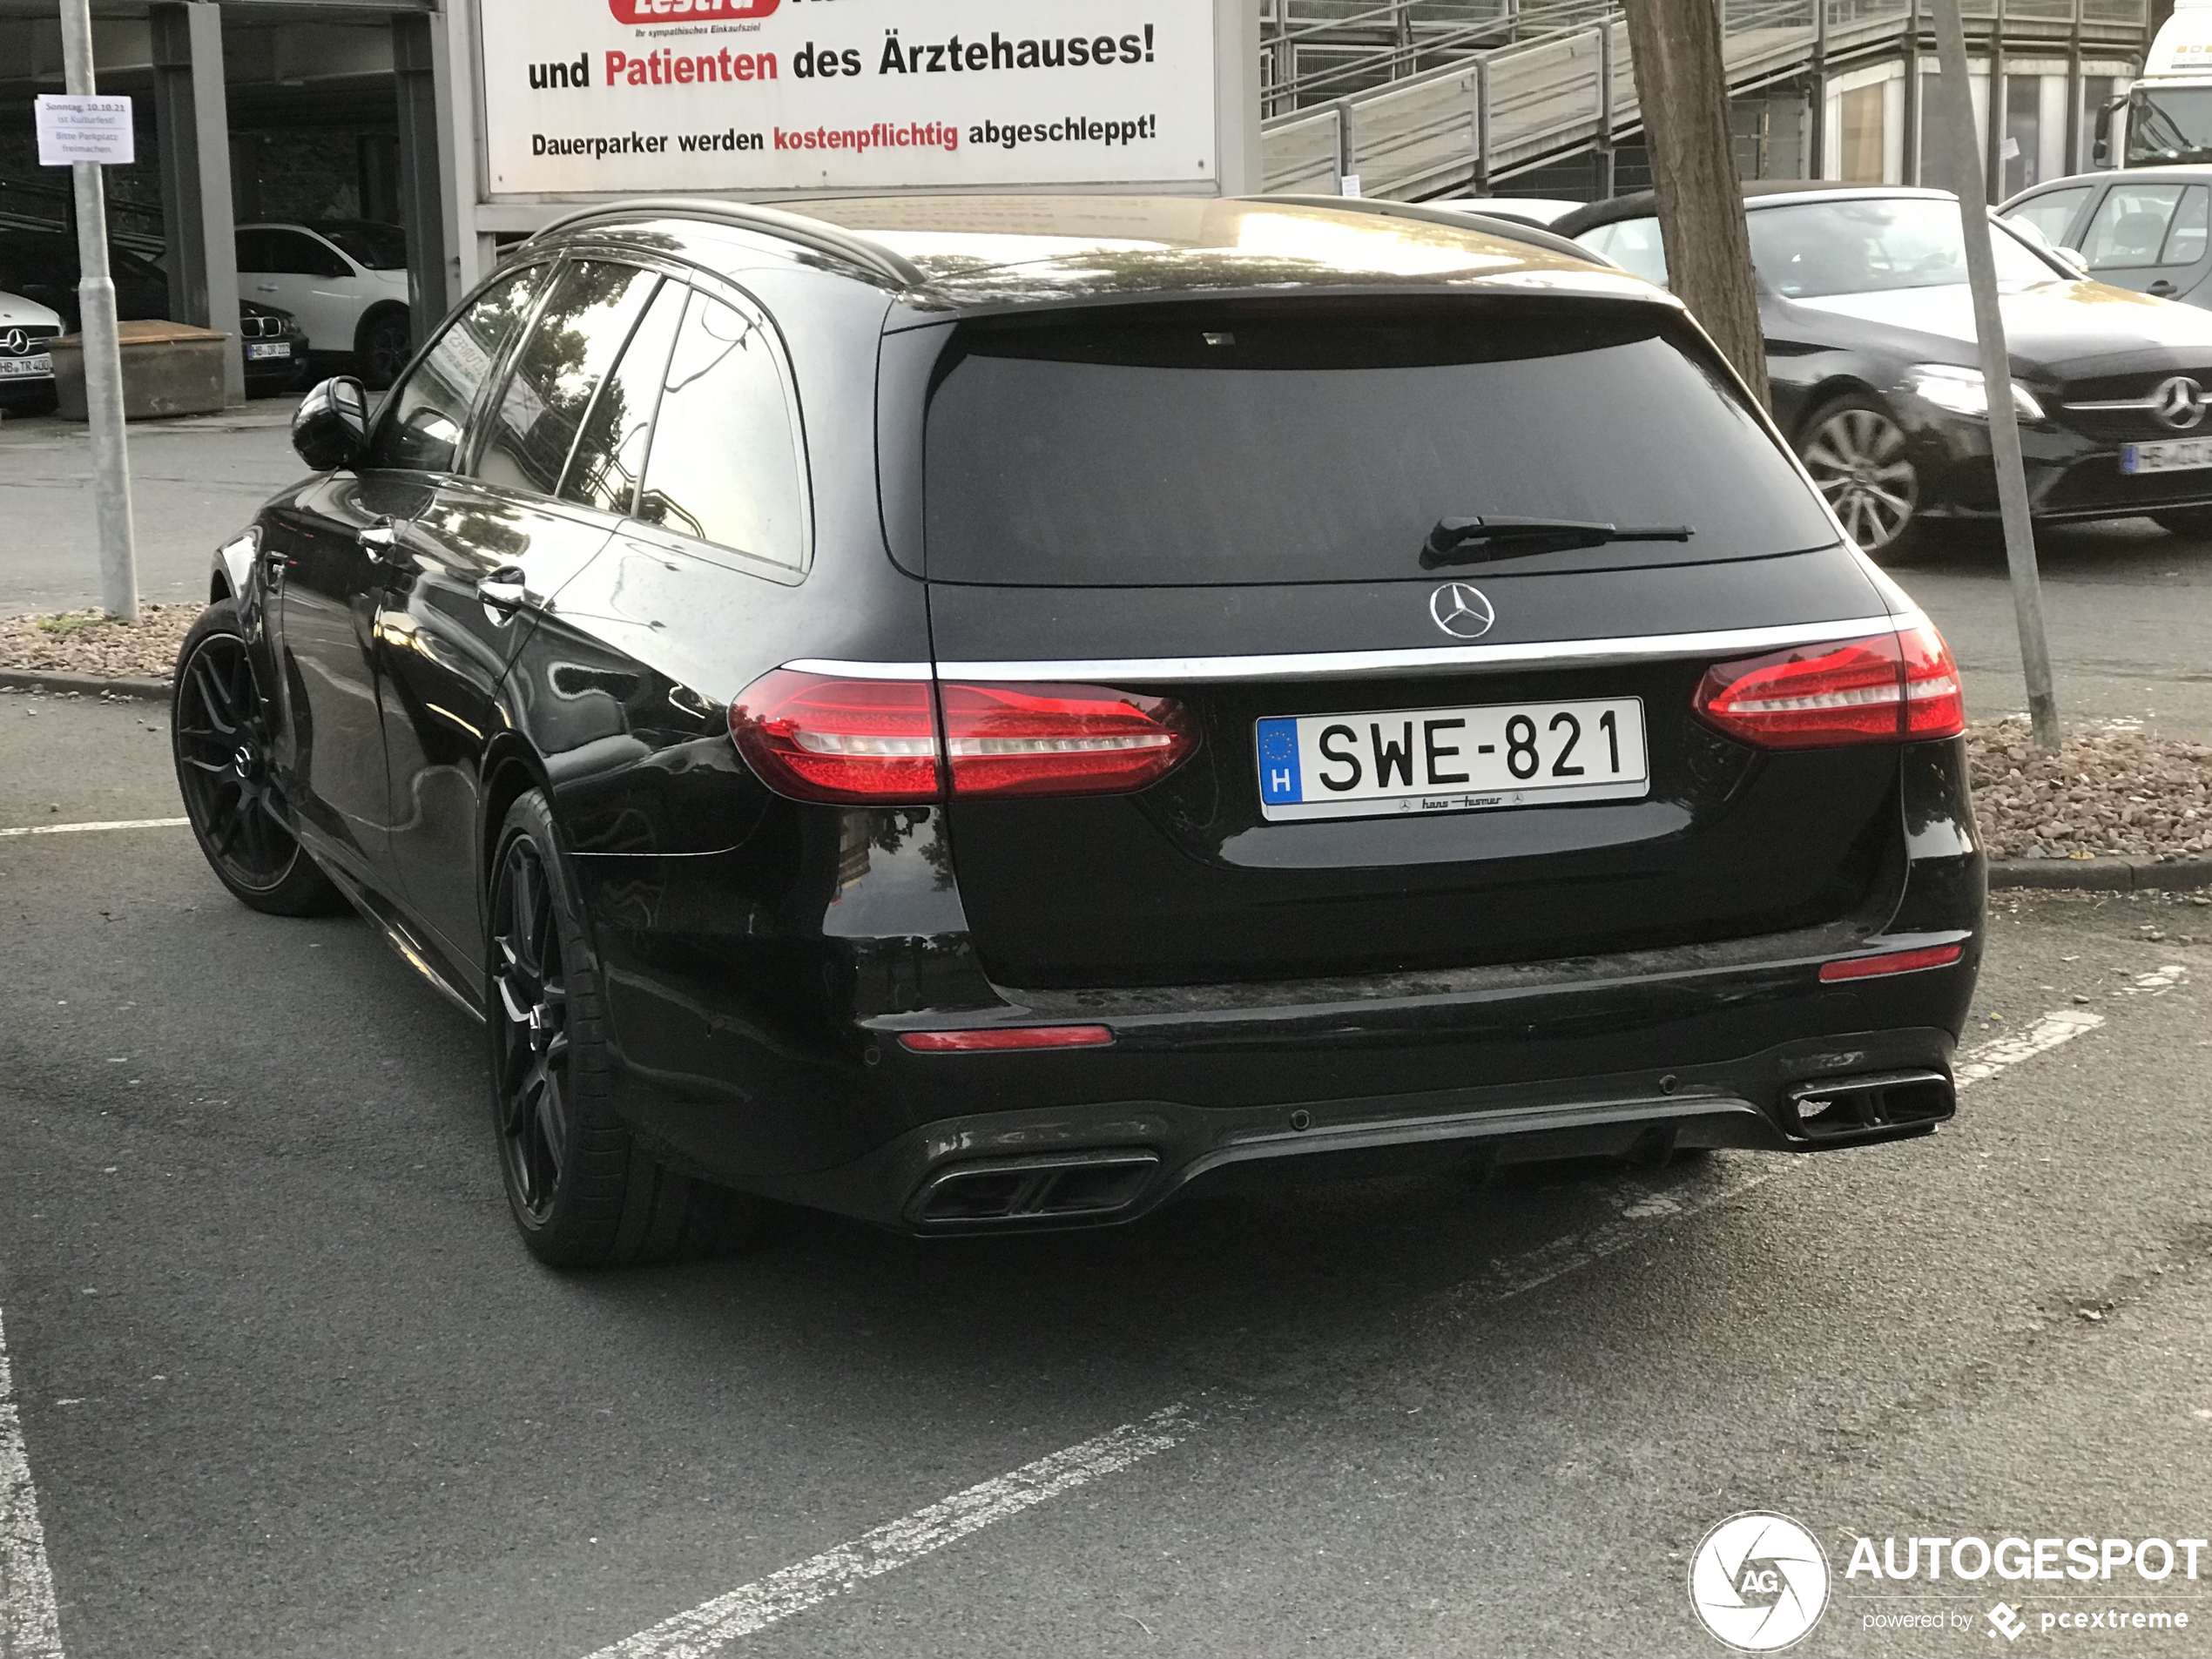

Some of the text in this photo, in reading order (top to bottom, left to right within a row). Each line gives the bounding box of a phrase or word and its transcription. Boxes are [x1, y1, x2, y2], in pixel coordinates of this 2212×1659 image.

[635, 23, 761, 38] Ihr sympathisches Einkaufsziel
[528, 23, 1155, 90] und Patienten des Ärztehauses!
[56, 132, 118, 142] Bitte Parkplatz
[532, 114, 1157, 160] Dauerparker werden kostenpflichtig abgeschleppt!
[19, 361, 31, 372] TR
[1271, 709, 1621, 792] H SWE-821
[1422, 798, 1448, 809] hans
